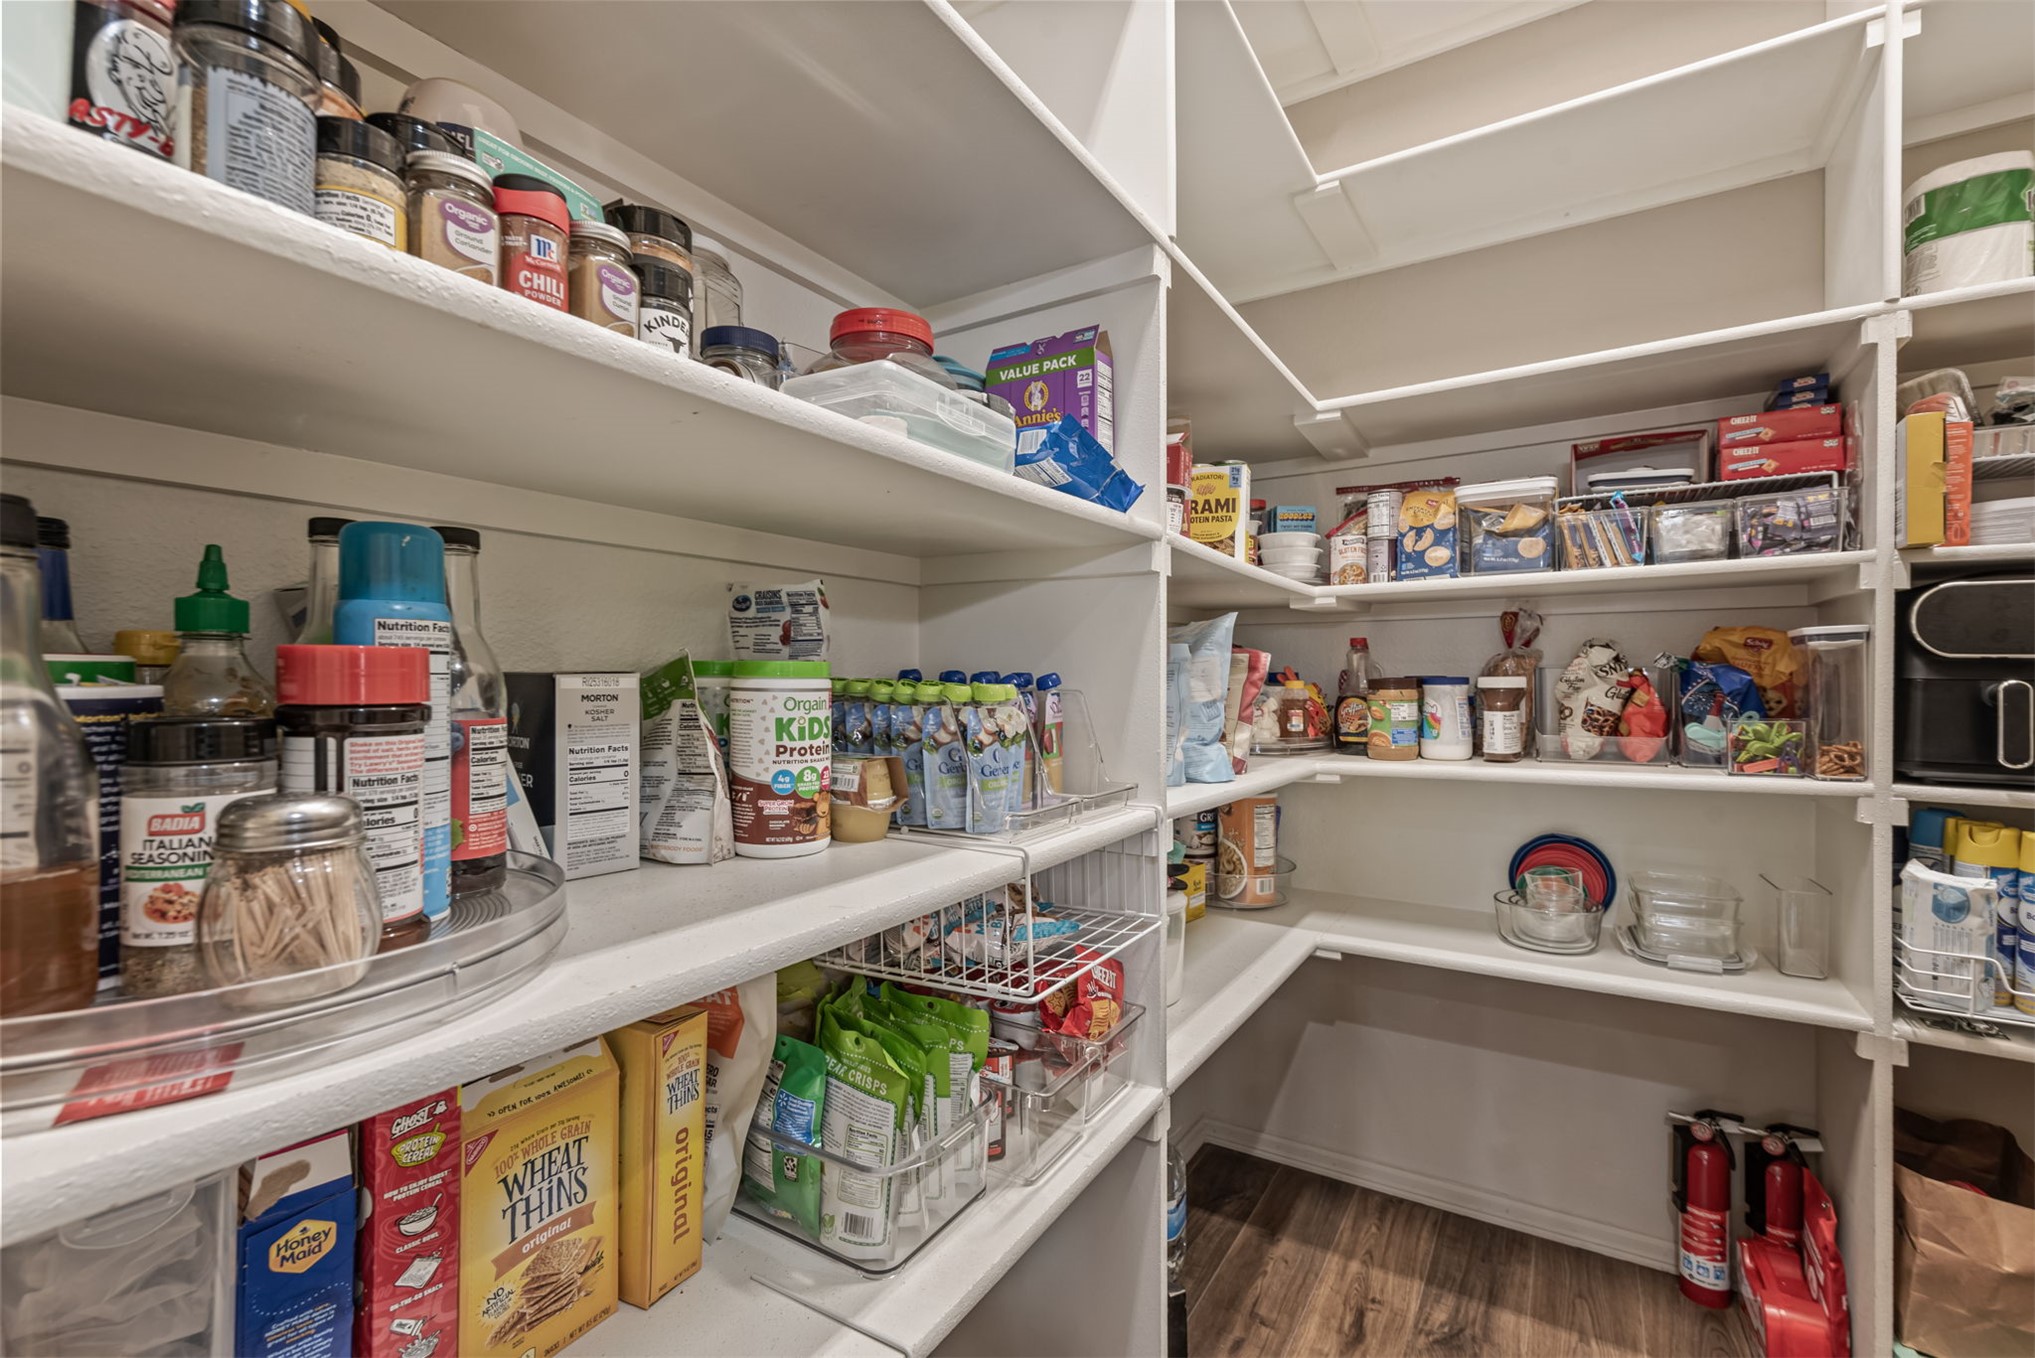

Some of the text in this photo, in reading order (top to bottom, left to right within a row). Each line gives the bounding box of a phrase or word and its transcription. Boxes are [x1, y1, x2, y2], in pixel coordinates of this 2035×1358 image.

[445, 202, 488, 226] Organic
[519, 270, 564, 299] CHILI
[601, 268, 631, 289] Organic
[524, 289, 562, 306] POWDER
[1000, 354, 1077, 381] VALUE PACK
[1079, 372, 1091, 382] 22
[1190, 514, 1233, 524] OTEIN PASTA
[378, 621, 430, 631] Nutrition
[581, 693, 619, 702] MORTON
[783, 696, 827, 715] Orgain
[471, 726, 500, 734] Nutrition
[569, 746, 606, 755] Nutrition
[775, 740, 830, 758] Protein
[471, 756, 497, 764] Calories
[352, 775, 398, 787] Nutrition
[569, 770, 629, 783] Calories 0
[777, 774, 790, 784] 4g
[803, 769, 817, 781] 8g
[150, 815, 200, 832] BADIA
[143, 836, 212, 851] ITALIAN
[130, 849, 215, 865] SEASONIN
[667, 1068, 701, 1096] WHEAT
[848, 1069, 888, 1096] CRISPS
[498, 1101, 517, 1115] OPEN
[519, 1096, 534, 1107] FOR
[553, 1072, 586, 1092] AWESOME!
[391, 1102, 438, 1139] GHOST
[397, 1135, 442, 1152] PROTEIN
[521, 1130, 558, 1160] WHOLE
[560, 1120, 592, 1141] GRAIN
[402, 1146, 435, 1163] CEREAL
[497, 1135, 589, 1203] WHEAT
[671, 1126, 692, 1245] original
[276, 1227, 333, 1258] Honey
[396, 1232, 439, 1254] CLASSIC BOWL
[522, 1217, 572, 1254] original
[280, 1241, 322, 1268] Maid
[487, 1287, 505, 1305] NO
